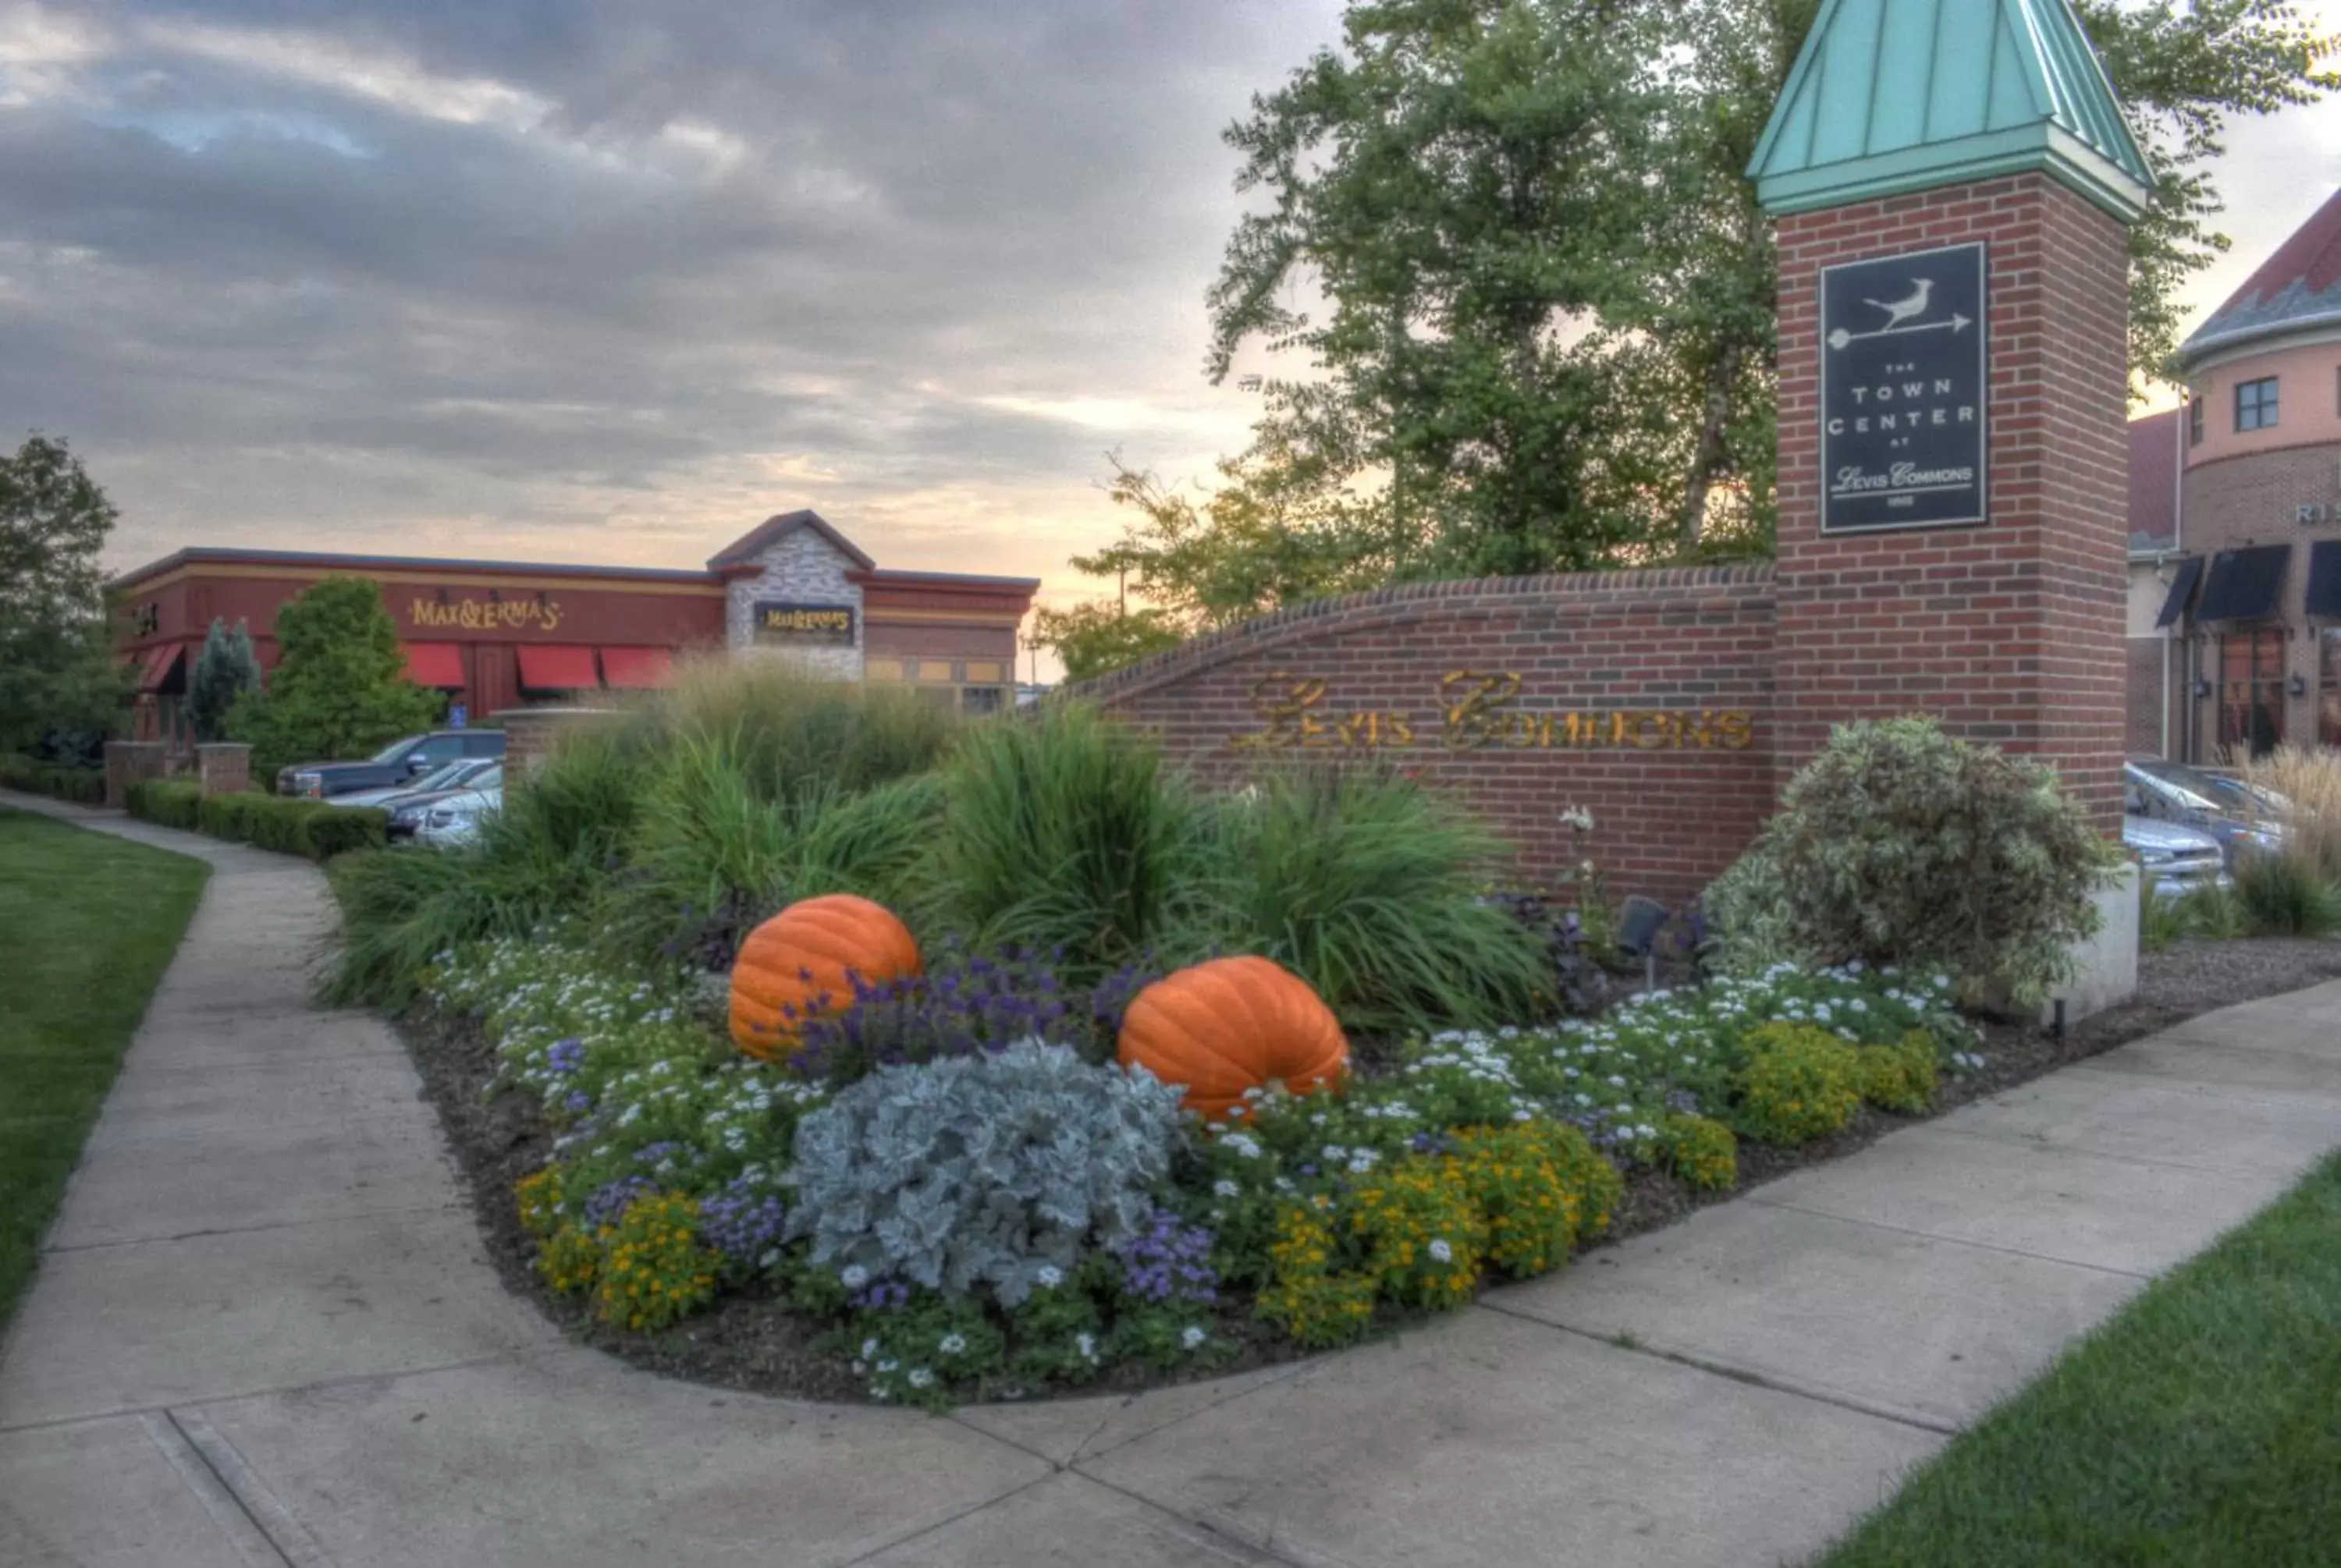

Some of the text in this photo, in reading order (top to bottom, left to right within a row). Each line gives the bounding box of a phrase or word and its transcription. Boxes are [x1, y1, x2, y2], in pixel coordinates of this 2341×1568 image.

[1885, 362, 1916, 374] THE
[1852, 378, 1952, 403] TOWN
[1828, 406, 1974, 435] CENTER
